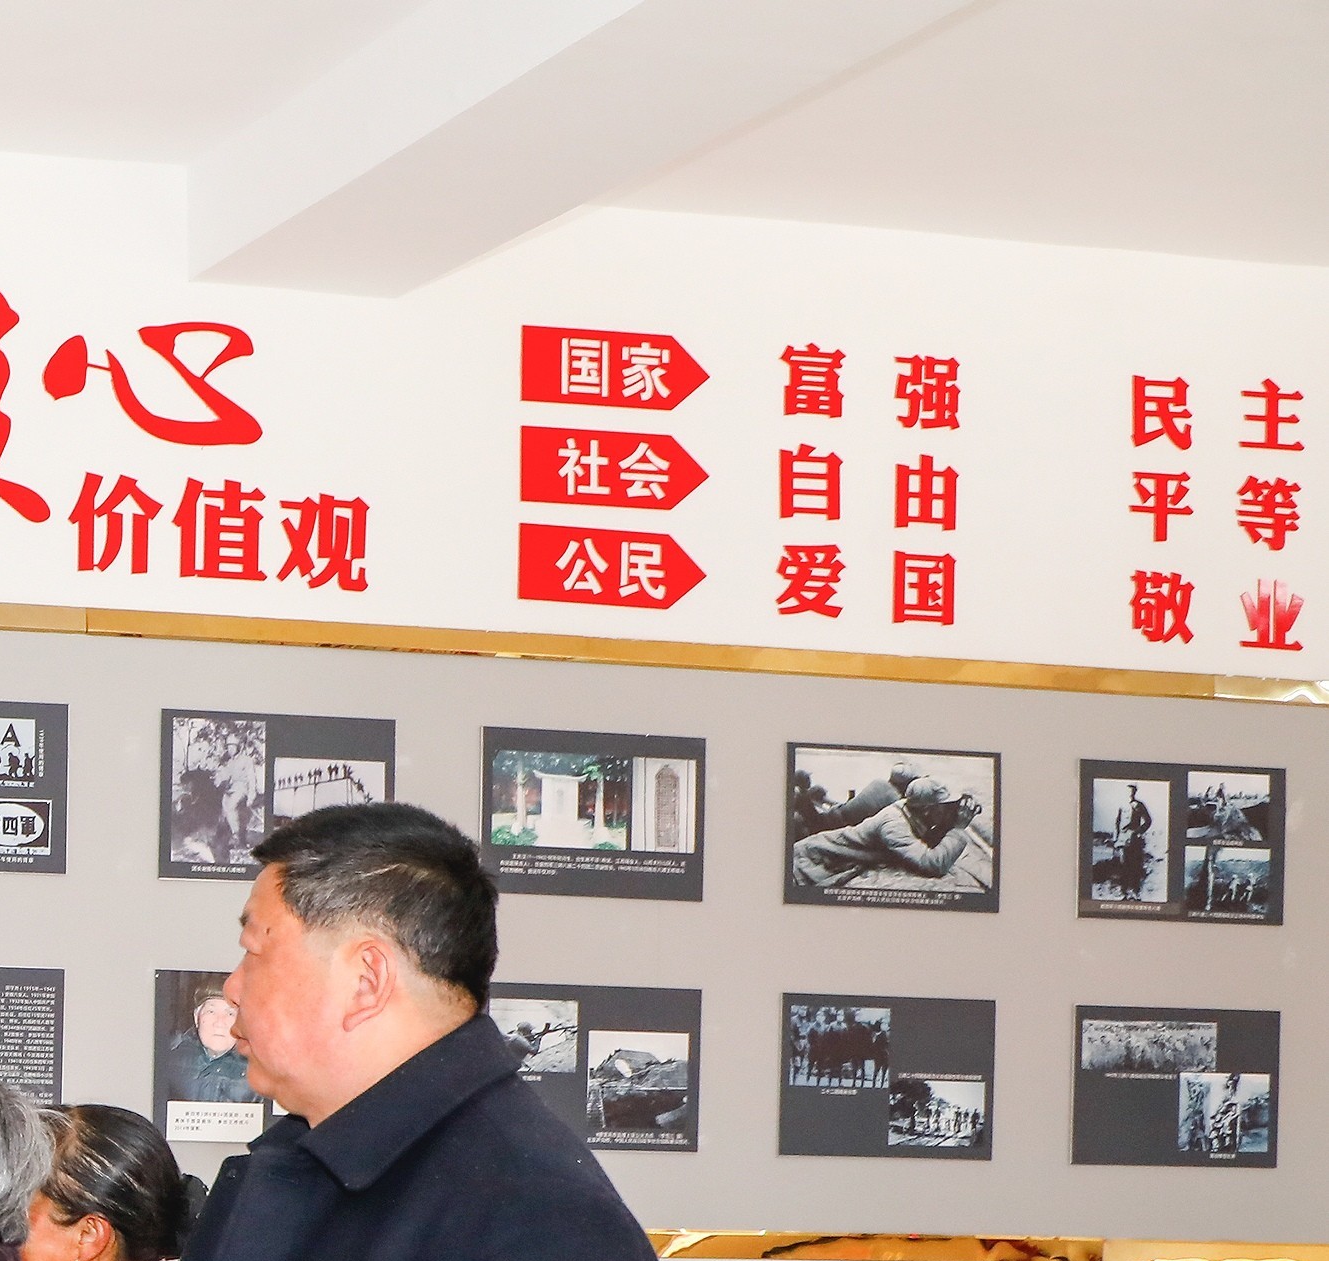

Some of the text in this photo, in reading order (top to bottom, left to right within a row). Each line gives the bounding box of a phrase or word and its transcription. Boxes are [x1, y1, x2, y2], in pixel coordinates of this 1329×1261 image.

[560, 336, 1305, 452] 国家 富强 民主
[68, 472, 369, 591] 价值观
[557, 437, 1303, 552] 社会 自由 平等
[556, 538, 1305, 651] 公民 爱国 敬业
